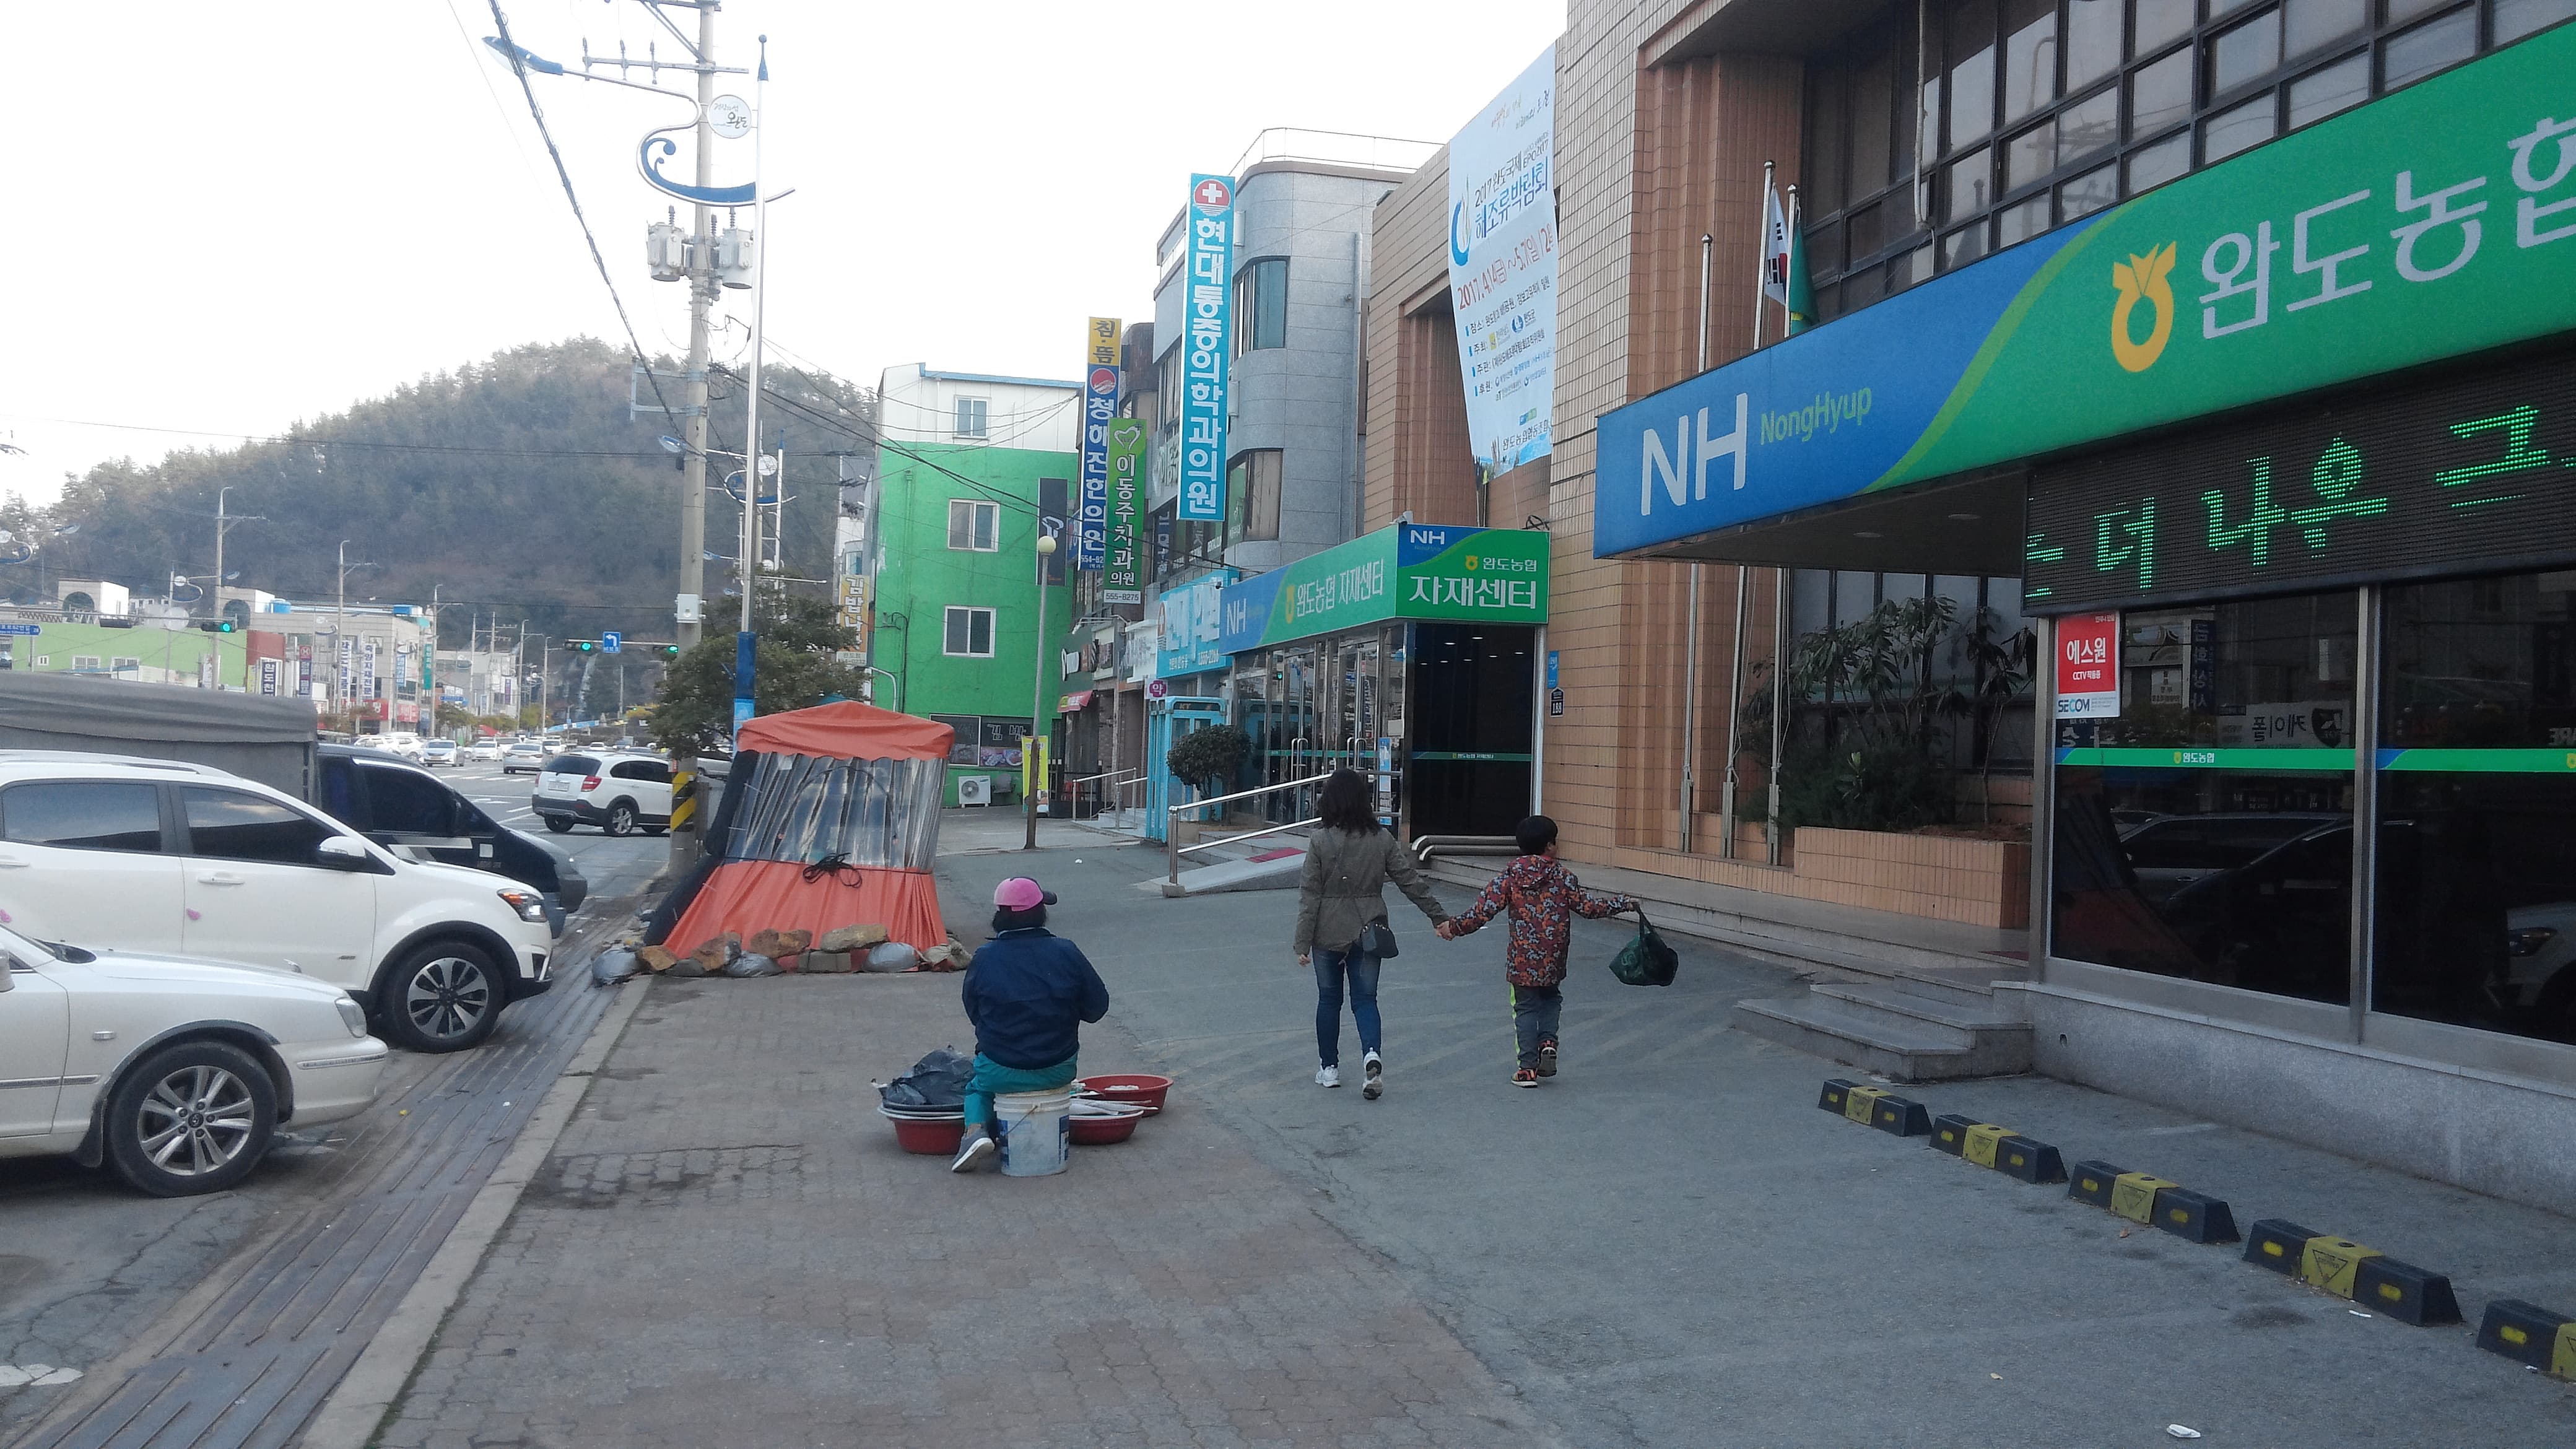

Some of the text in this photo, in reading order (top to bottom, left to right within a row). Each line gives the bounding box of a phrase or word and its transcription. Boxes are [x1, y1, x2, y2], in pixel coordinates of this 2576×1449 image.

[726, 111, 747, 129] 완도
[1186, 217, 1225, 514] 현대통증의학과의원
[1641, 388, 1872, 516] NH NongHyup
[1083, 397, 1116, 552] 청해진한의원
[1114, 454, 1137, 570] 이동주치과
[1410, 529, 1445, 545] NH
[1482, 557, 1537, 572] 완도농협
[1110, 572, 1134, 586] 의원
[1105, 593, 1139, 601] 555-8275
[1227, 598, 1247, 636] NH
[1297, 574, 1336, 617] 완도농협
[1339, 557, 1384, 605] 자재센터
[1409, 576, 1536, 609] 자재센터
[2066, 637, 2106, 665] 에스원
[1152, 683, 1163, 695] 약
[2058, 698, 2090, 713] SECOM
[2183, 752, 2215, 764] 완도농협
